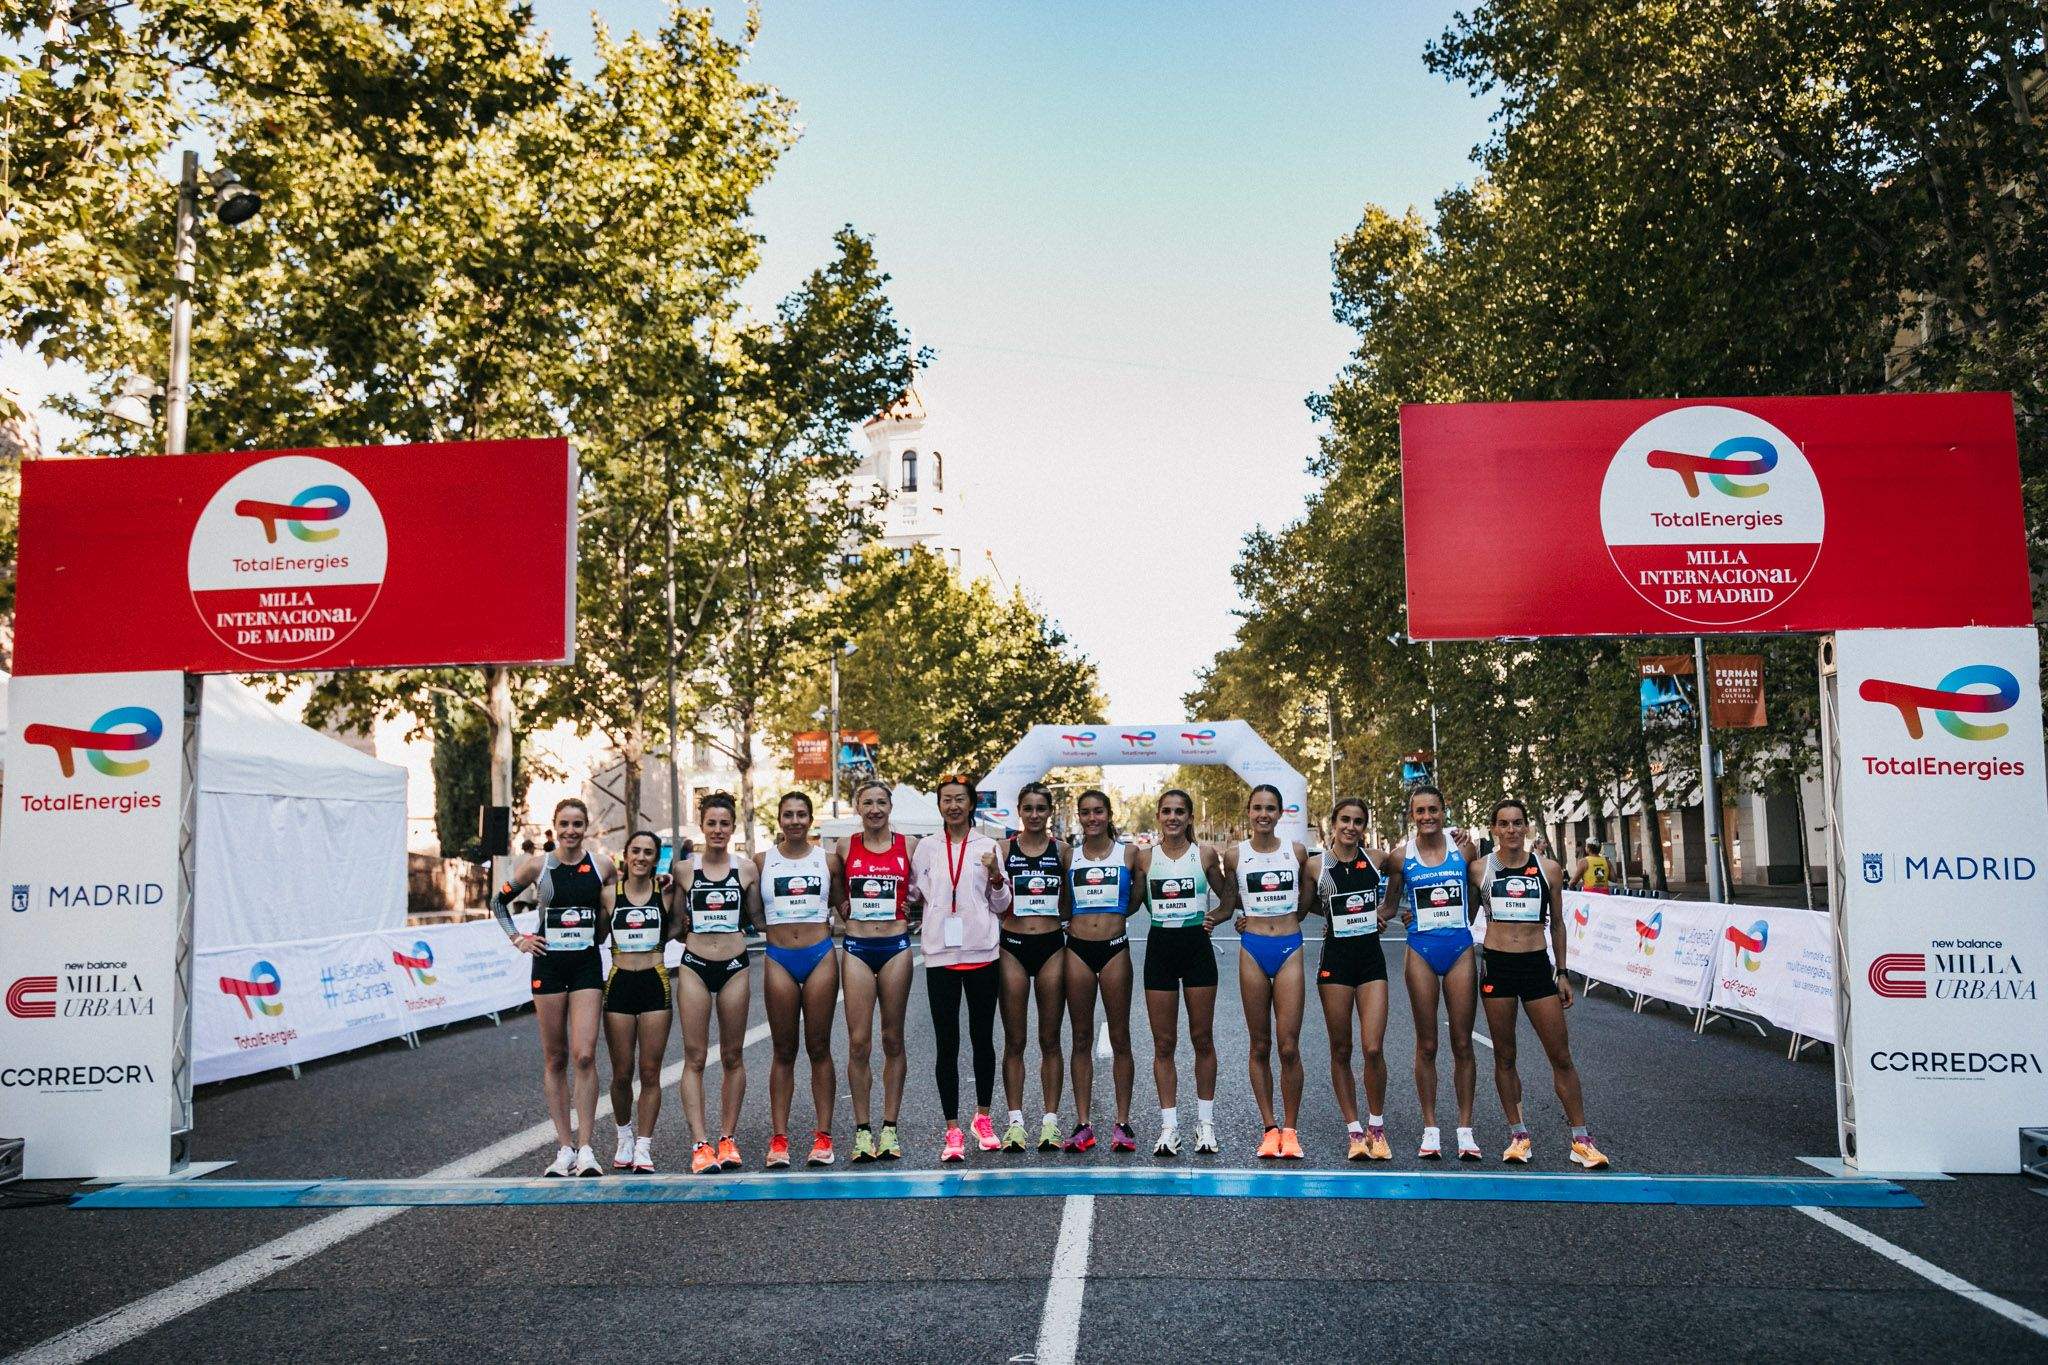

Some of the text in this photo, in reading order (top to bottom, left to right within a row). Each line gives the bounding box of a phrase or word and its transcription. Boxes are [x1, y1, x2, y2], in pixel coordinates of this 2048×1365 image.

[1650, 510, 1783, 530] TotalEnergies
[233, 554, 349, 573] TotalEnergies
[1686, 550, 1748, 566] MILLA
[259, 592, 314, 608] MILLA
[1664, 587, 1774, 605] DE MADRID
[237, 626, 335, 645] DE MADRID
[1642, 664, 1666, 674] ISLA
[1715, 668, 1758, 678] FERNÁN
[1716, 677, 1758, 687] GÓMEZ
[1862, 756, 2025, 780] TotalEnergies
[21, 793, 161, 814] TotalEnergies
[1906, 856, 2036, 881] MADRID
[807, 876, 820, 887] 24
[882, 881, 893, 890] 31
[1047, 878, 1058, 887] 22
[1180, 879, 1193, 889] 25
[1526, 880, 1538, 890] 34
[49, 884, 163, 907] MADRID
[725, 891, 738, 901] 23
[1364, 892, 1374, 903] 26
[1450, 887, 1460, 897] 21
[645, 909, 657, 919] 30
[1110, 938, 1123, 946] NIKE
[1932, 939, 2002, 949] new balance
[87, 961, 127, 970] balance
[1932, 954, 2022, 974] MILLA
[66, 974, 142, 993] MILLA
[1935, 979, 2038, 1000] URBANA
[64, 997, 153, 1017] URBANA
[234, 1029, 297, 1050] TotalEnergies
